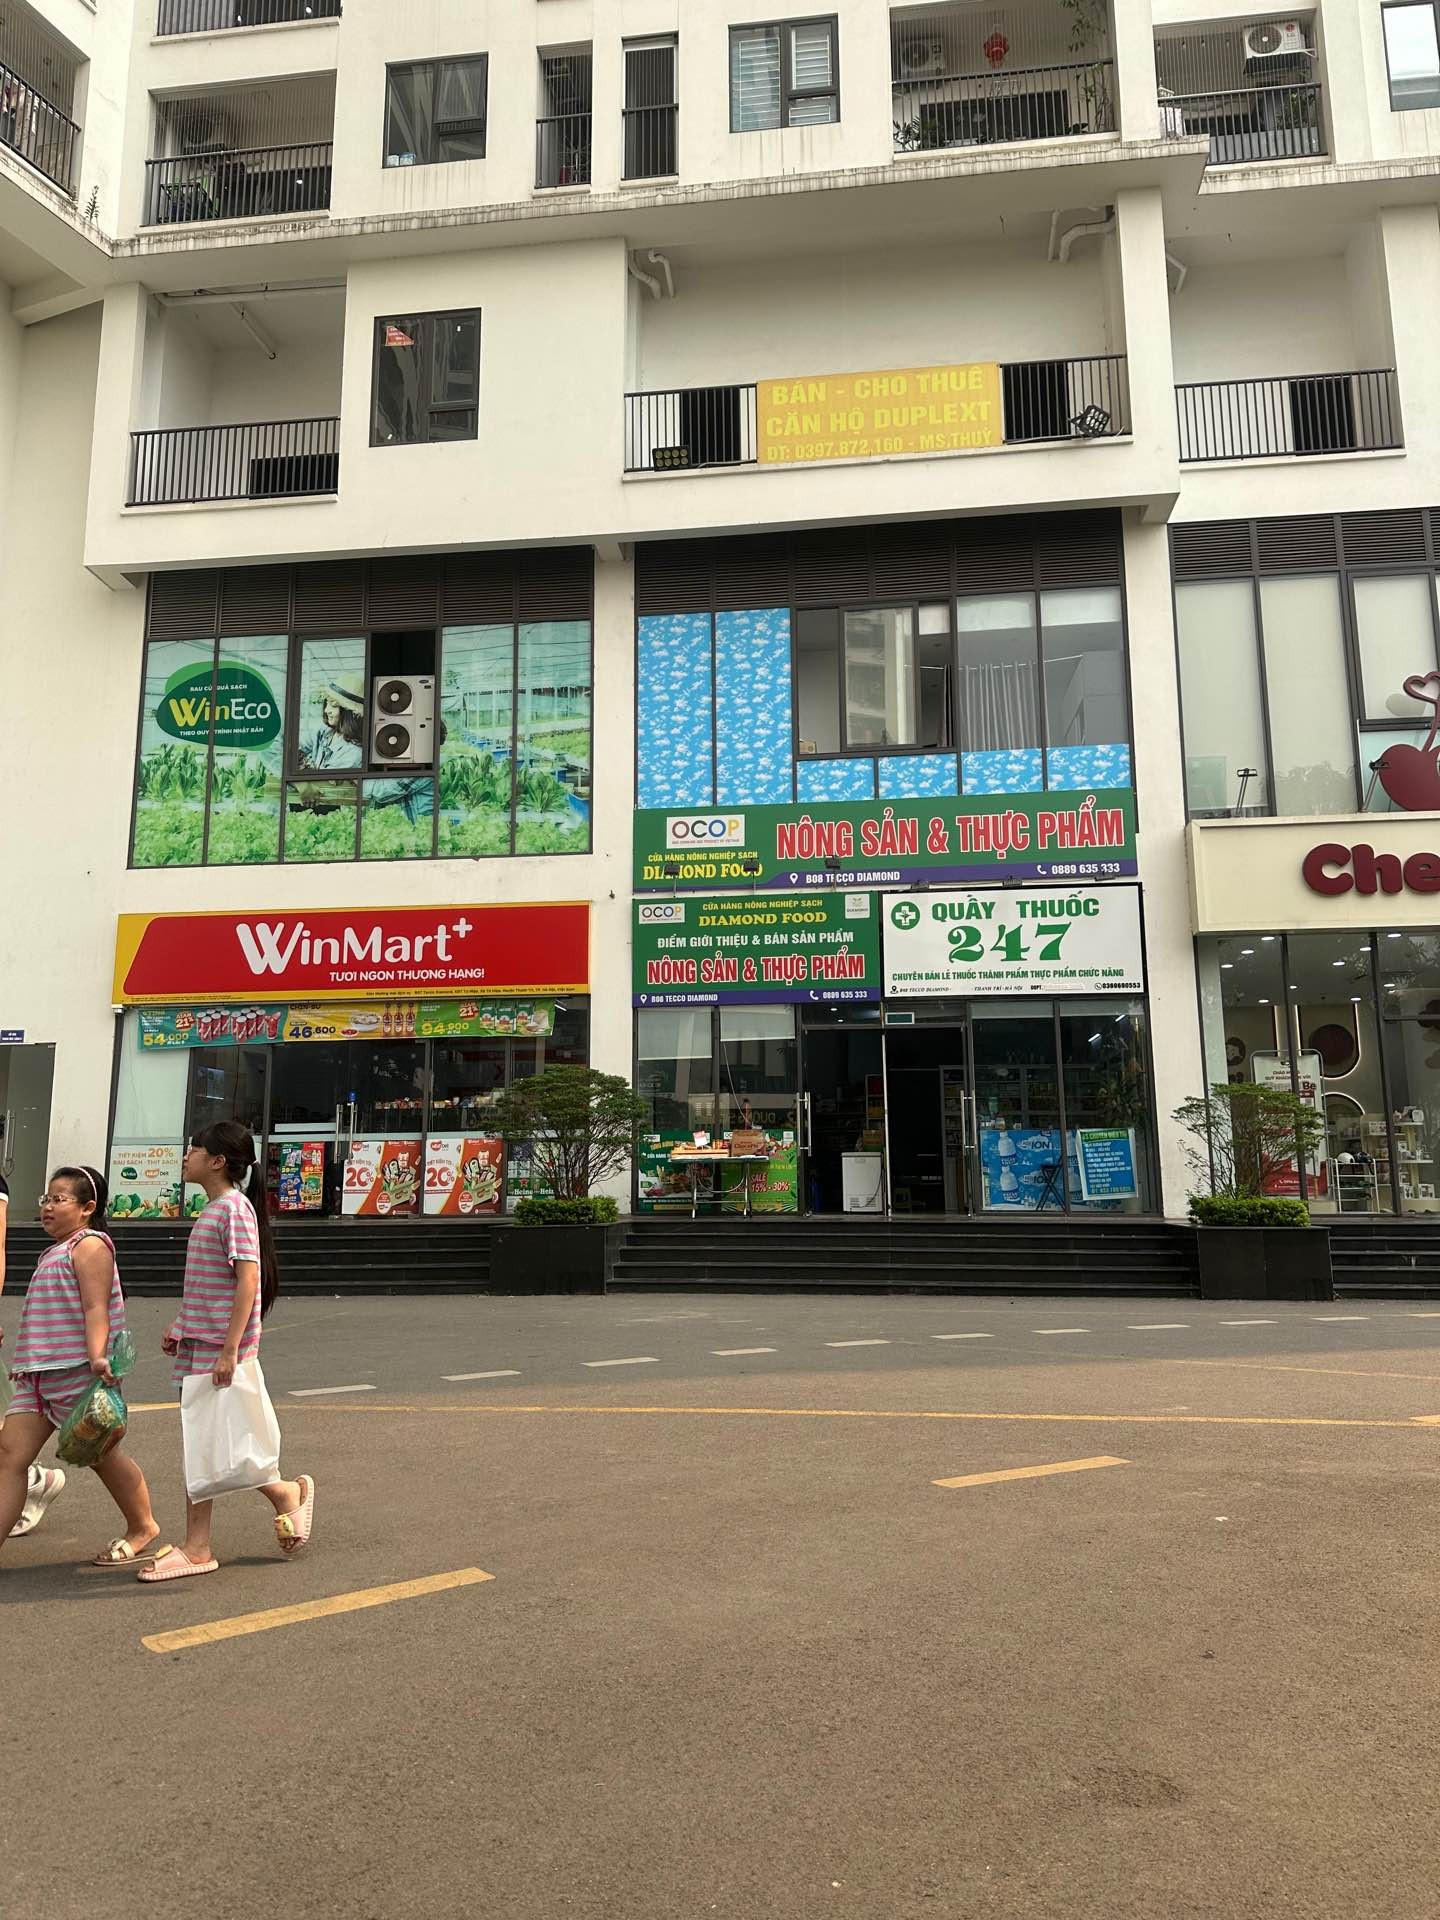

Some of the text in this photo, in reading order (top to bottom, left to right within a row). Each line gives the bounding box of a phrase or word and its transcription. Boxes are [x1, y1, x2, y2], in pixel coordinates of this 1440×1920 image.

[772, 381, 827, 406] BÁN
[854, 376, 908, 399] CHO
[917, 367, 984, 393] THUÊ
[766, 400, 991, 438] CĂN HỘ DUPLEXT
[168, 697, 272, 727] WinEco
[672, 819, 740, 839] OCOP
[776, 795, 1125, 860] NÔNG SẢN & THỰC PHẨM
[648, 852, 663, 862] CỬA
[664, 852, 685, 862] HÀNG
[687, 851, 707, 860] NÔNG
[709, 851, 736, 861] NGHIỆP
[1052, 862, 1120, 874] 0889 635 333
[857, 871, 901, 883] DIAMOND
[642, 906, 682, 918] OCOP
[702, 902, 719, 911] CỬA
[720, 901, 743, 910] HÀNG
[744, 900, 768, 909] NÔNG
[769, 899, 799, 909] NGHIỆP
[931, 890, 1100, 922] QUẦY THUỐC
[699, 911, 827, 927] DIAMOND FOOD
[657, 928, 854, 948] ĐIỂM GIỚI THIỆU & BÁN SẢN PHẨM
[947, 922, 1072, 963] 247
[647, 945, 865, 985] NÔNG SẢN & THỰC PHẨM
[329, 968, 485, 982] TƯƠI NGON THƯỢNG HẠNG!
[892, 971, 924, 981] CHUYÊN
[925, 970, 941, 980] BÁN
[952, 968, 977, 979] THUỐC
[1005, 967, 1028, 979] PHẨM
[1030, 968, 1051, 980] THỰC
[1053, 966, 1077, 978] PHẨM
[1078, 967, 1100, 977] CHỨC
[1101, 966, 1124, 977] NĂNG
[665, 994, 686, 1003] TECCO
[687, 993, 718, 1002] DIAMOND
[841, 990, 852, 998] 635
[853, 990, 868, 998] 333
[421, 1023, 469, 1035] 94.900
[143, 1033, 189, 1046] 54.000
[1031, 1141, 1050, 1149] ION
[147, 1147, 174, 1158] 20%
[345, 1167, 374, 1187] 20%
[426, 1167, 454, 1187] 20%
[752, 1172, 767, 1181] SALE
[752, 1183, 767, 1192] 15%
[772, 1181, 789, 1191] 30%
